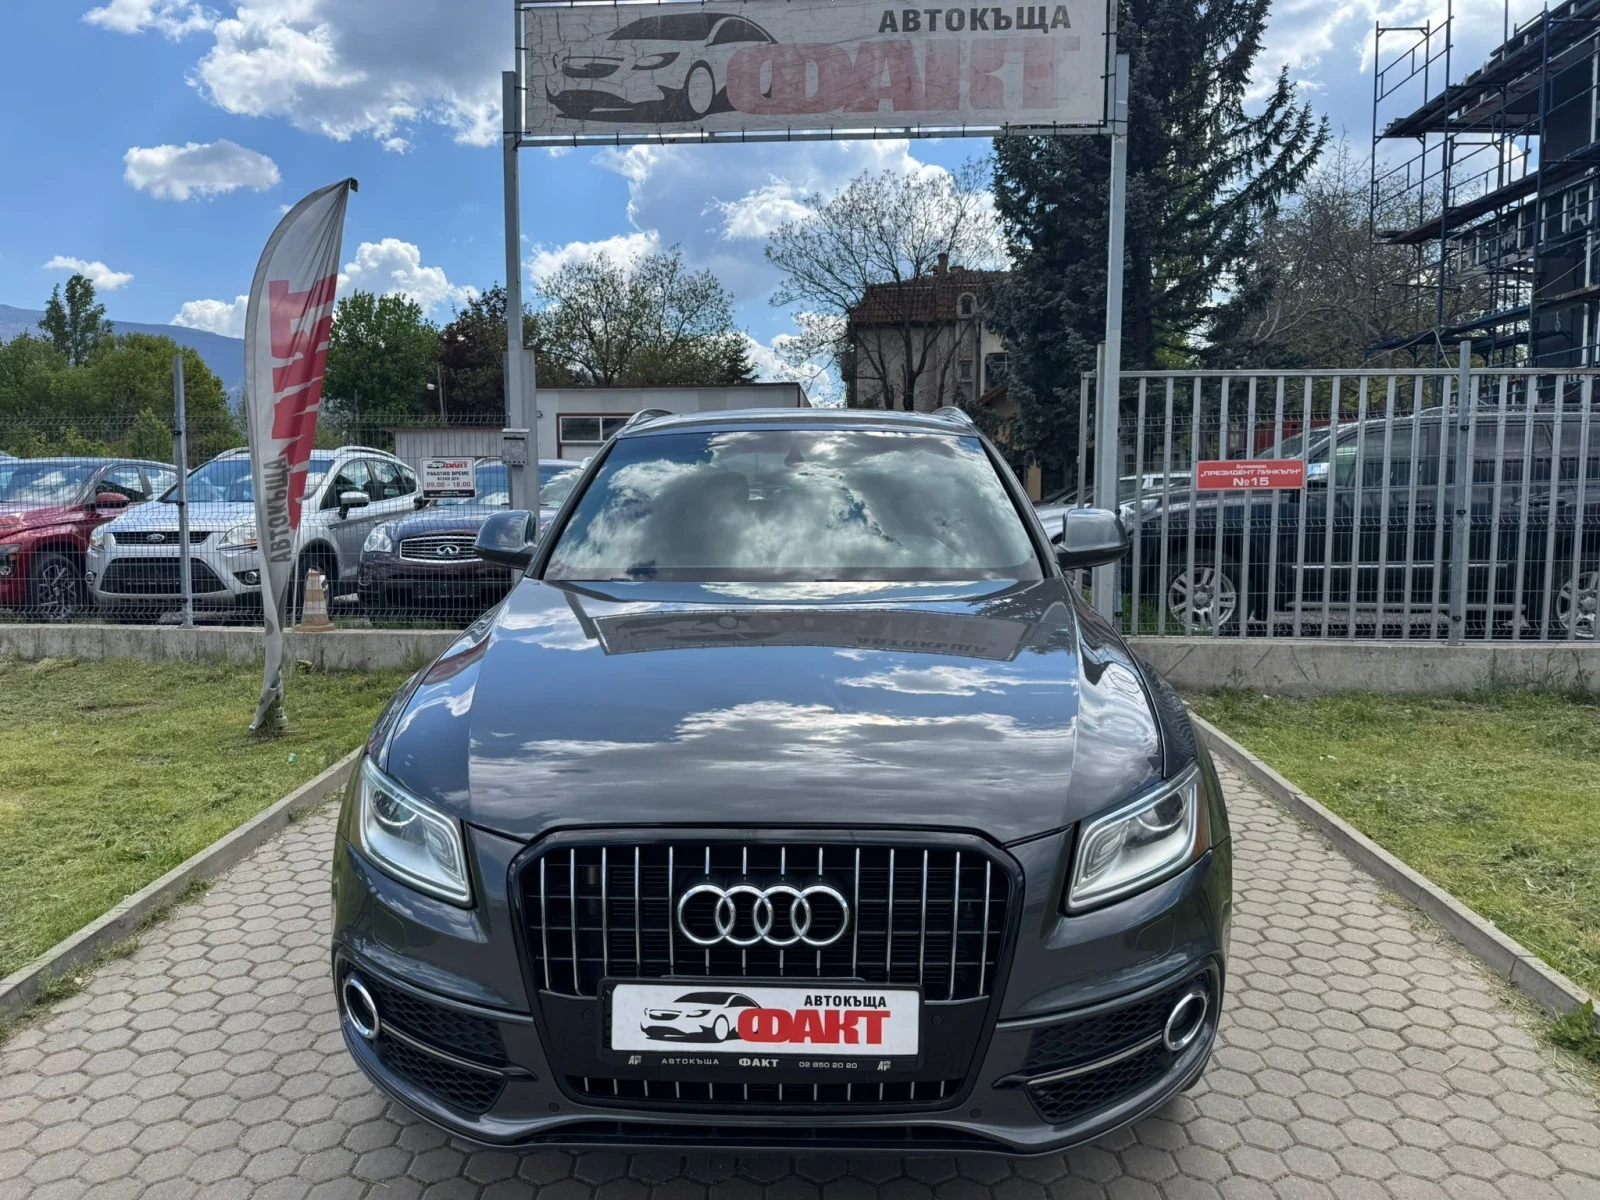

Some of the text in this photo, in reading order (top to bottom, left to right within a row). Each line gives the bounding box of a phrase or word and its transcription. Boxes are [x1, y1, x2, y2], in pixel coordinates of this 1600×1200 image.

[878, 4, 1072, 33] АВТОКЪЩА
[726, 36, 1081, 115] ФАКТ
[263, 456, 293, 563] АВТОКЪЩА
[804, 995, 887, 1009] АВТОКЪЩА
[737, 1008, 891, 1045] ФАКТ
[738, 1057, 780, 1068] ФАКТ
